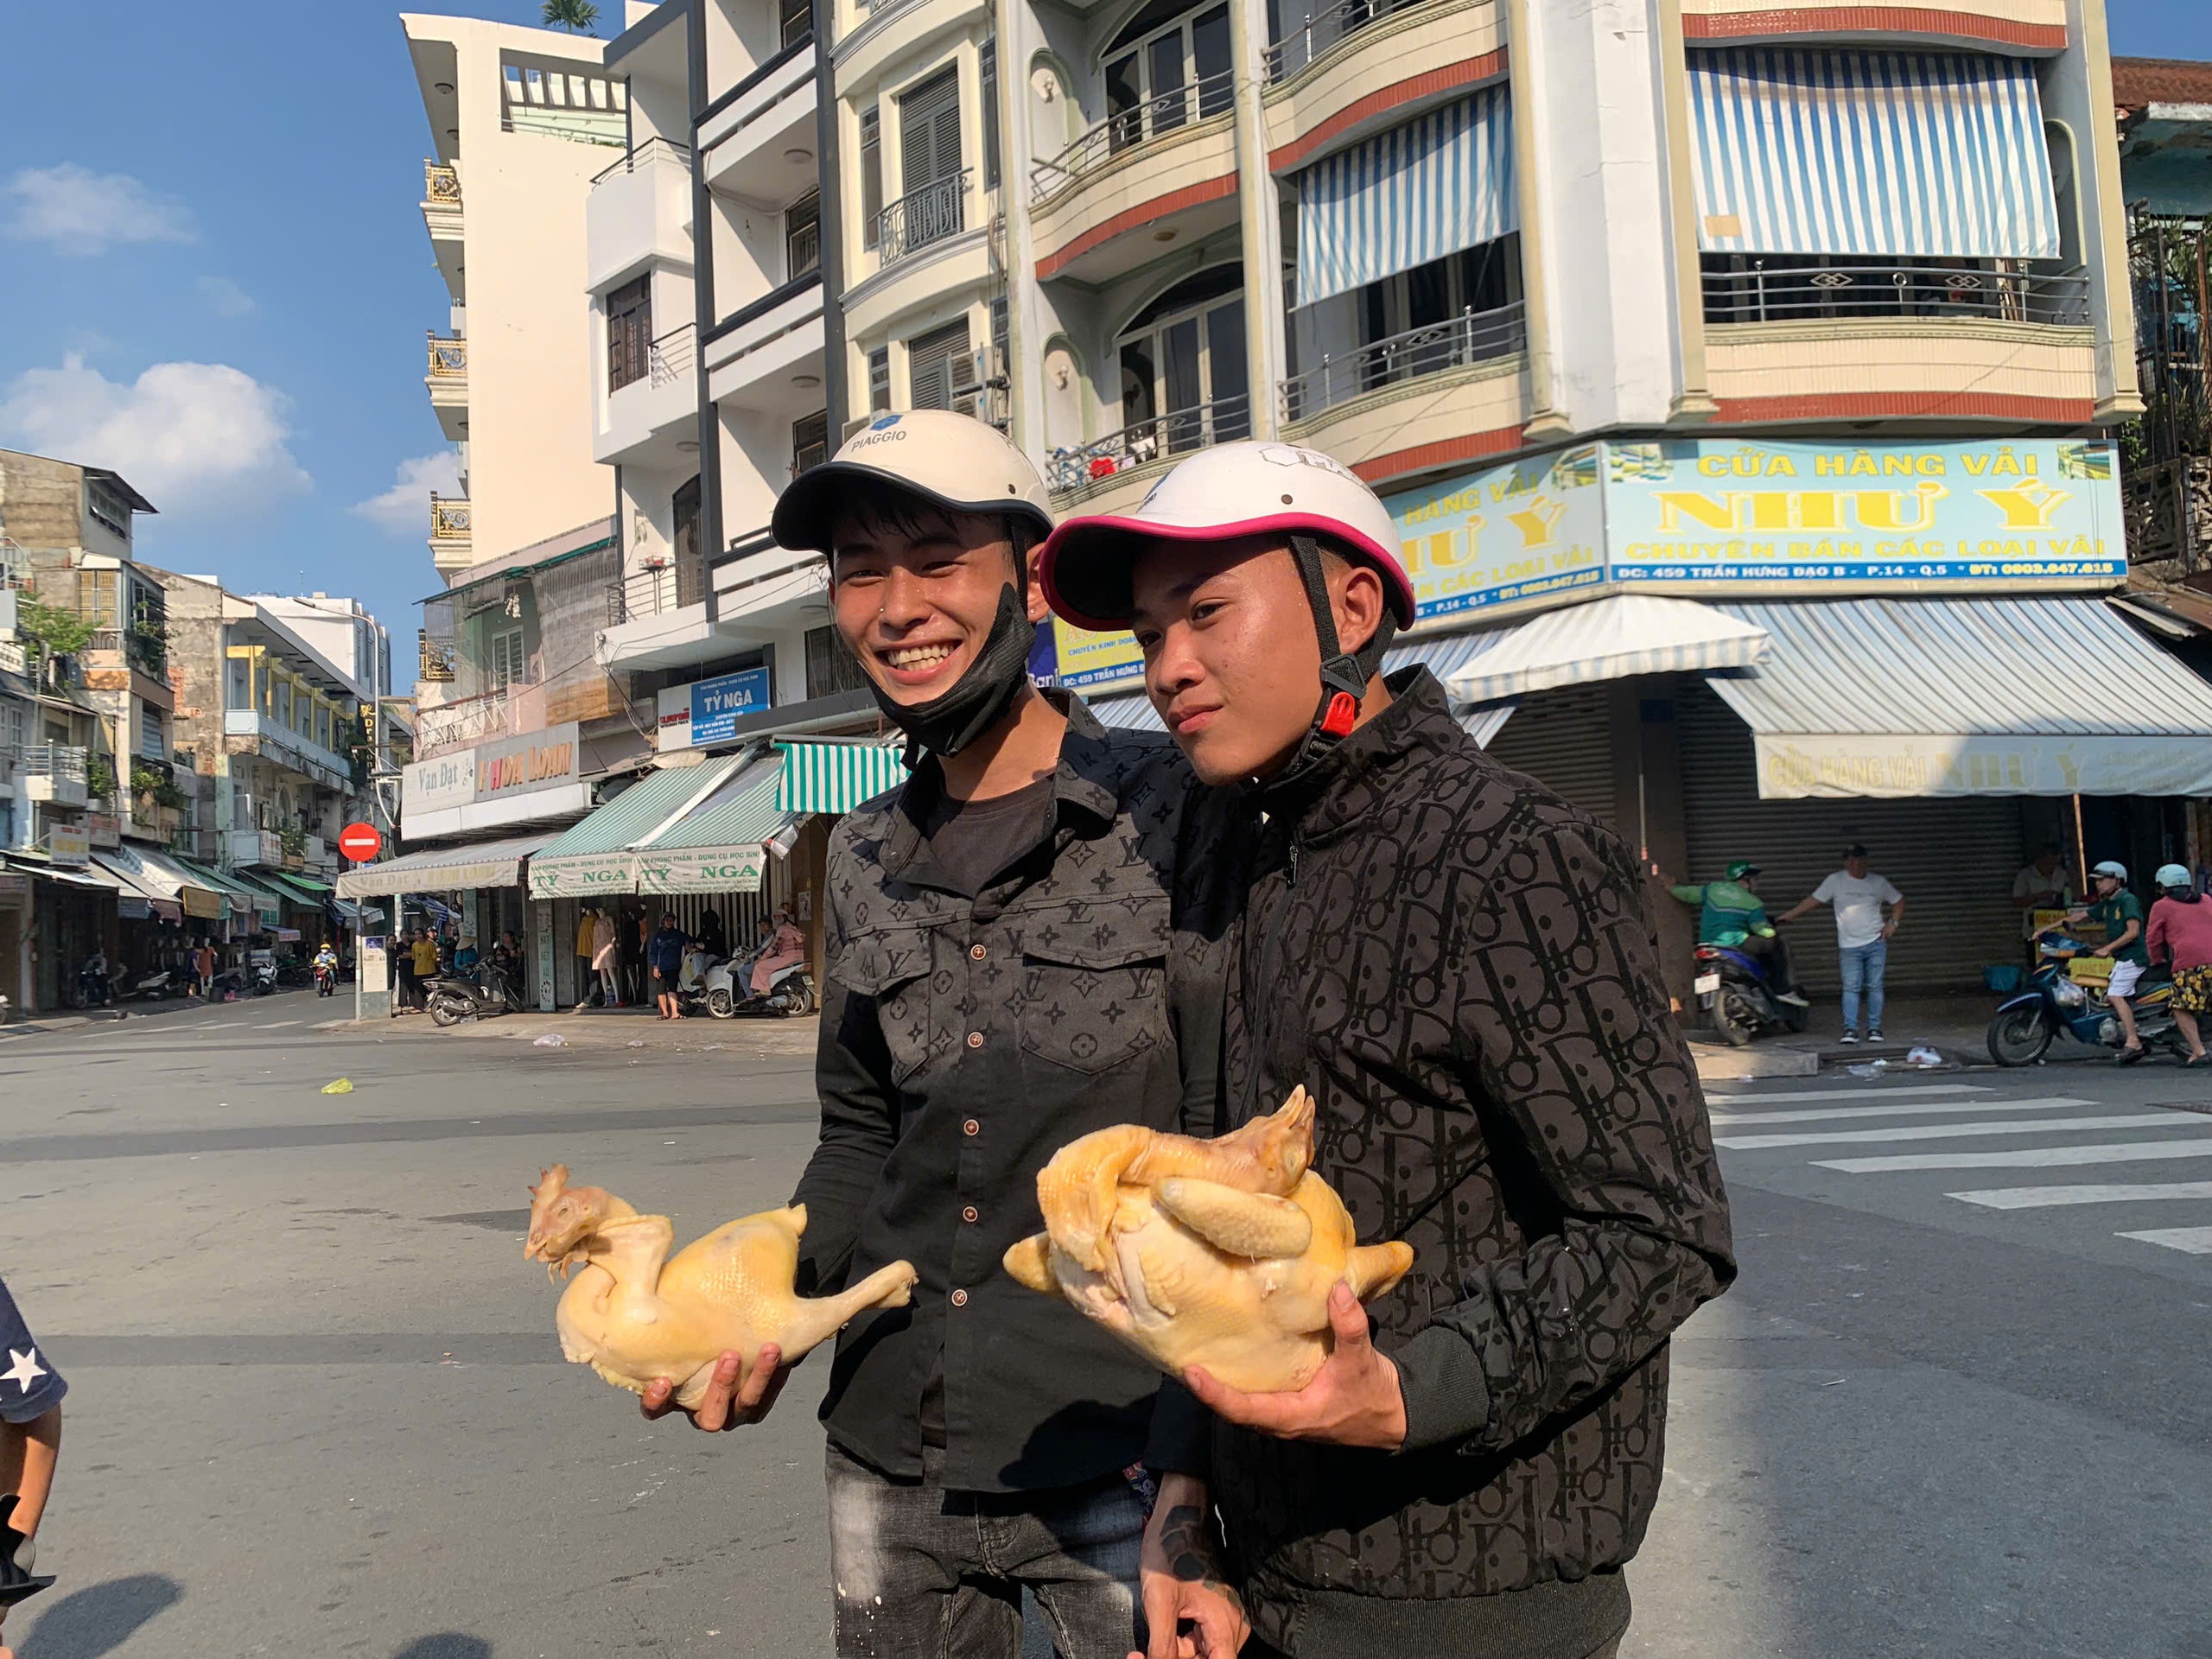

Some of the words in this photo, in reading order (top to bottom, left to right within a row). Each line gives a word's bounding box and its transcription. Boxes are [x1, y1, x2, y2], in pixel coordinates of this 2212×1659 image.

[851, 430, 907, 452] PIAGGIO
[1696, 447, 1797, 477] CỬA
[1815, 449, 1947, 476] HÀNG
[1961, 446, 2038, 476] VẢI
[1405, 487, 1480, 526] HÀNG
[1649, 480, 1950, 534] NHƯ
[1974, 477, 2074, 532] Ý
[1504, 495, 1569, 550] Ý
[1625, 537, 1776, 560] CHUYÊN
[1788, 537, 1862, 559] BÁN
[1874, 537, 1945, 557] CÁC
[1957, 539, 2037, 559] LOẠI
[2049, 534, 2105, 556] VẢI
[1440, 569, 1484, 593] CÁC
[1652, 566, 1685, 578] 459
[1867, 565, 1904, 576] P.14
[1920, 565, 1947, 576] Q.5
[1078, 674, 1093, 684] 459
[704, 690, 722, 713] TỶ
[724, 689, 753, 709] NGA
[582, 869, 628, 883] NGA
[700, 864, 759, 879] NGA
